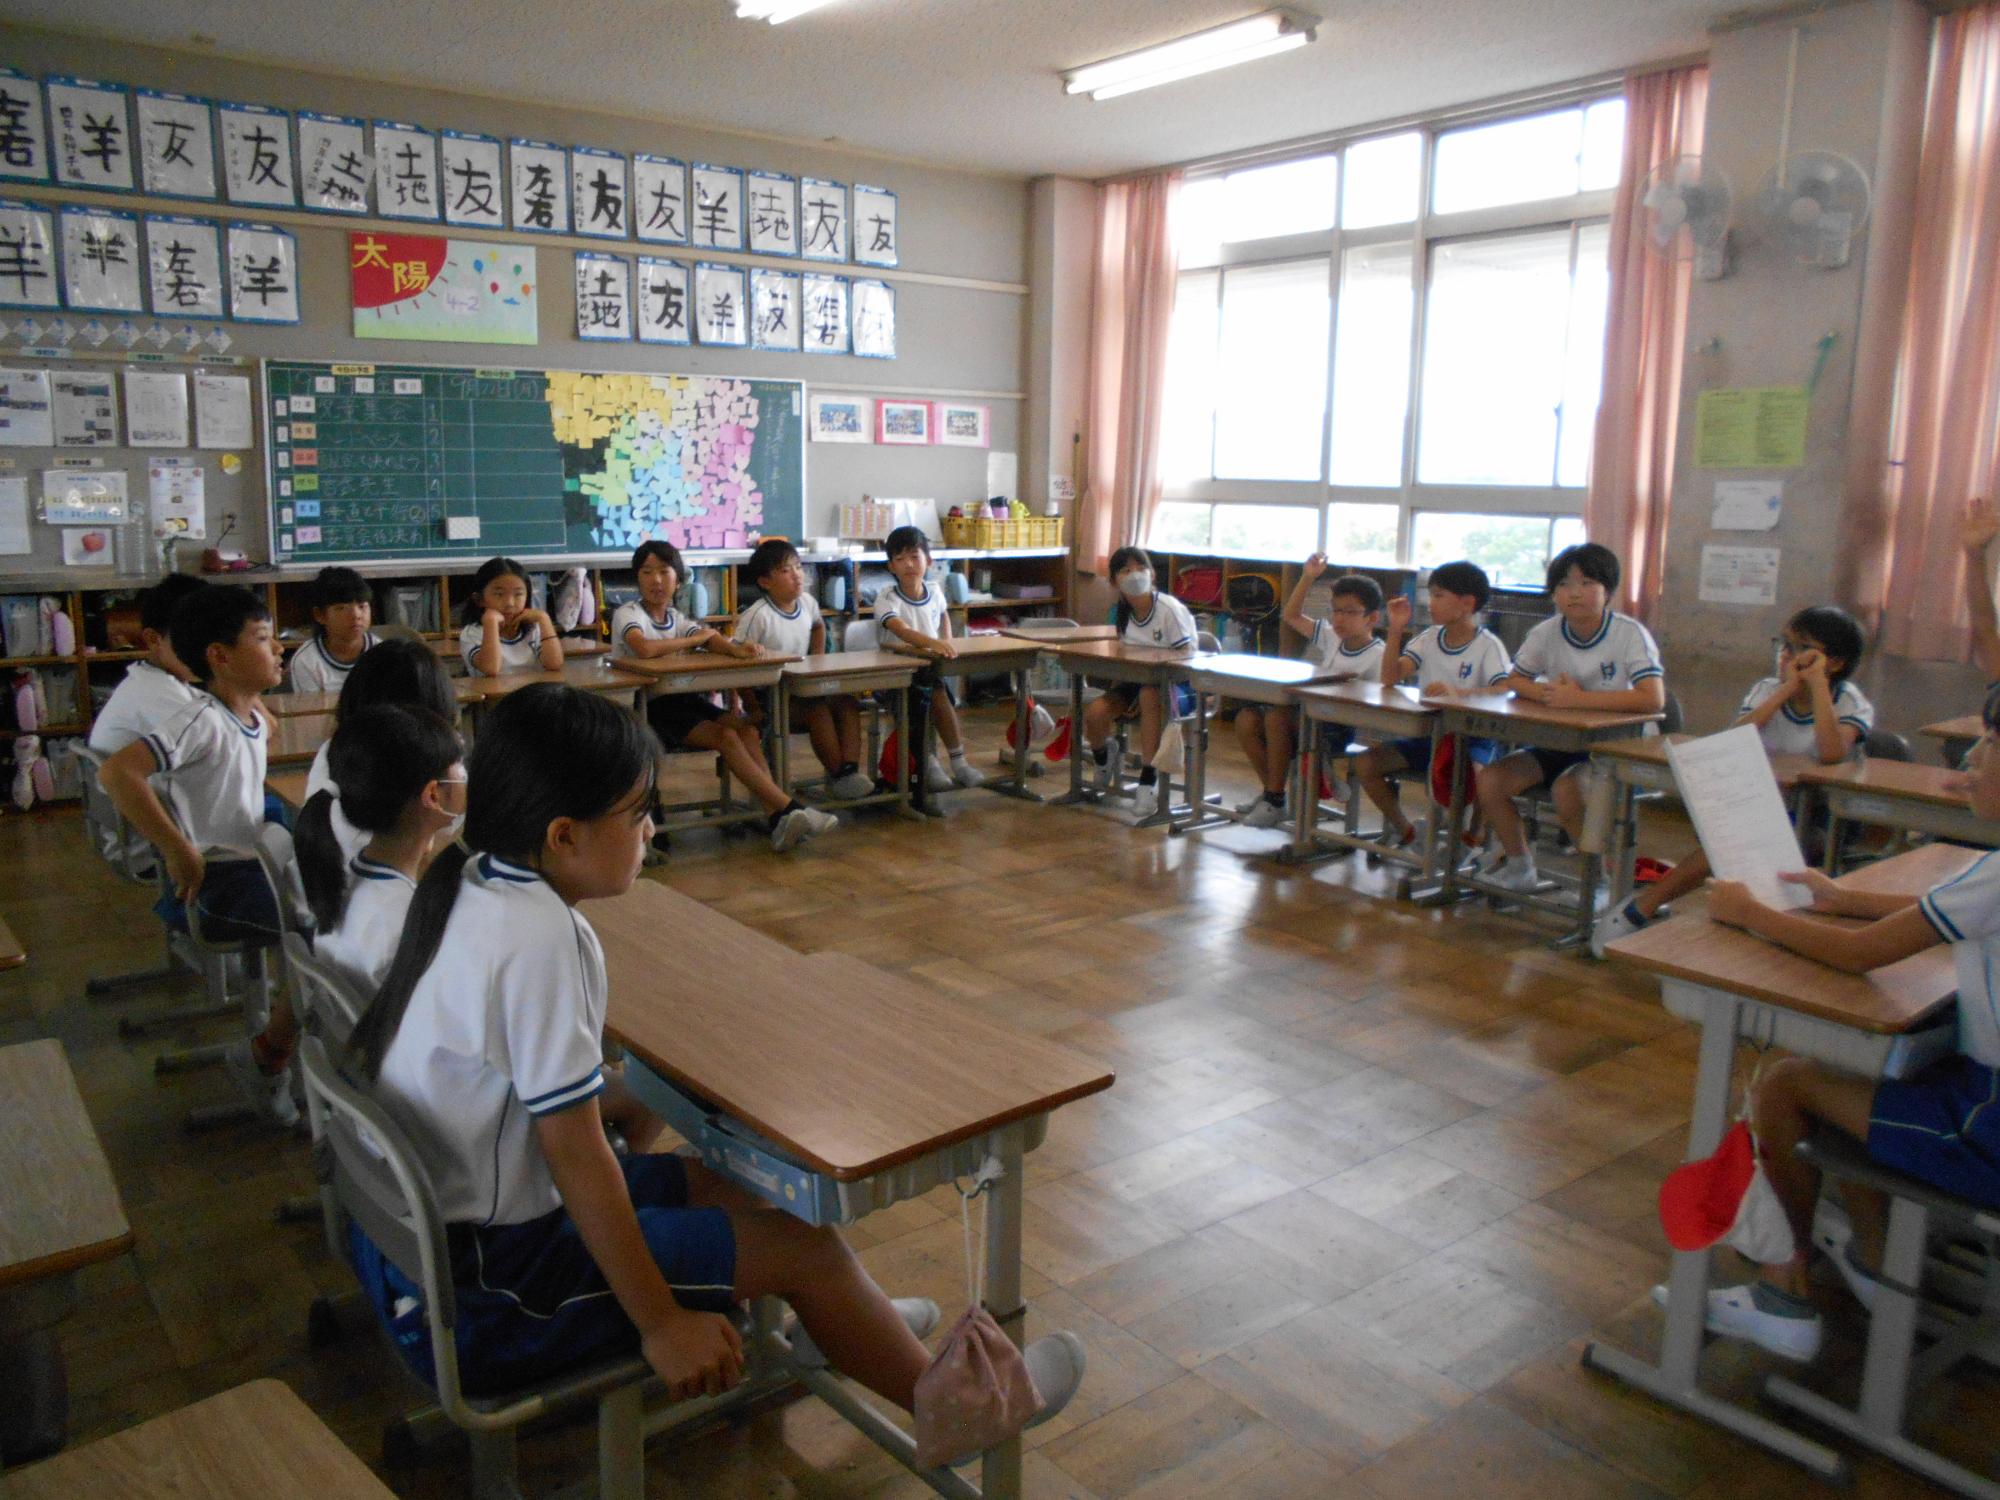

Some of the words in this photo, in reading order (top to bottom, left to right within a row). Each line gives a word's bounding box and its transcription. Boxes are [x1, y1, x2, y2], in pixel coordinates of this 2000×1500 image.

[81, 113, 122, 173] 羊
[153, 120, 196, 168] 友
[243, 126, 288, 188] 友
[395, 143, 430, 206] 土地
[453, 159, 498, 217] 友
[523, 164, 557, 228] 左右
[590, 169, 623, 230] 友
[646, 181, 685, 238] 友
[698, 192, 737, 245] 羊
[755, 188, 791, 242] 土地
[807, 199, 840, 254] 友
[868, 214, 894, 251] 友
[165, 241, 206, 307] 左右
[240, 255, 288, 306] 羊
[353, 237, 431, 294] 太陽
[589, 270, 622, 329] 土地
[650, 279, 684, 330] 友
